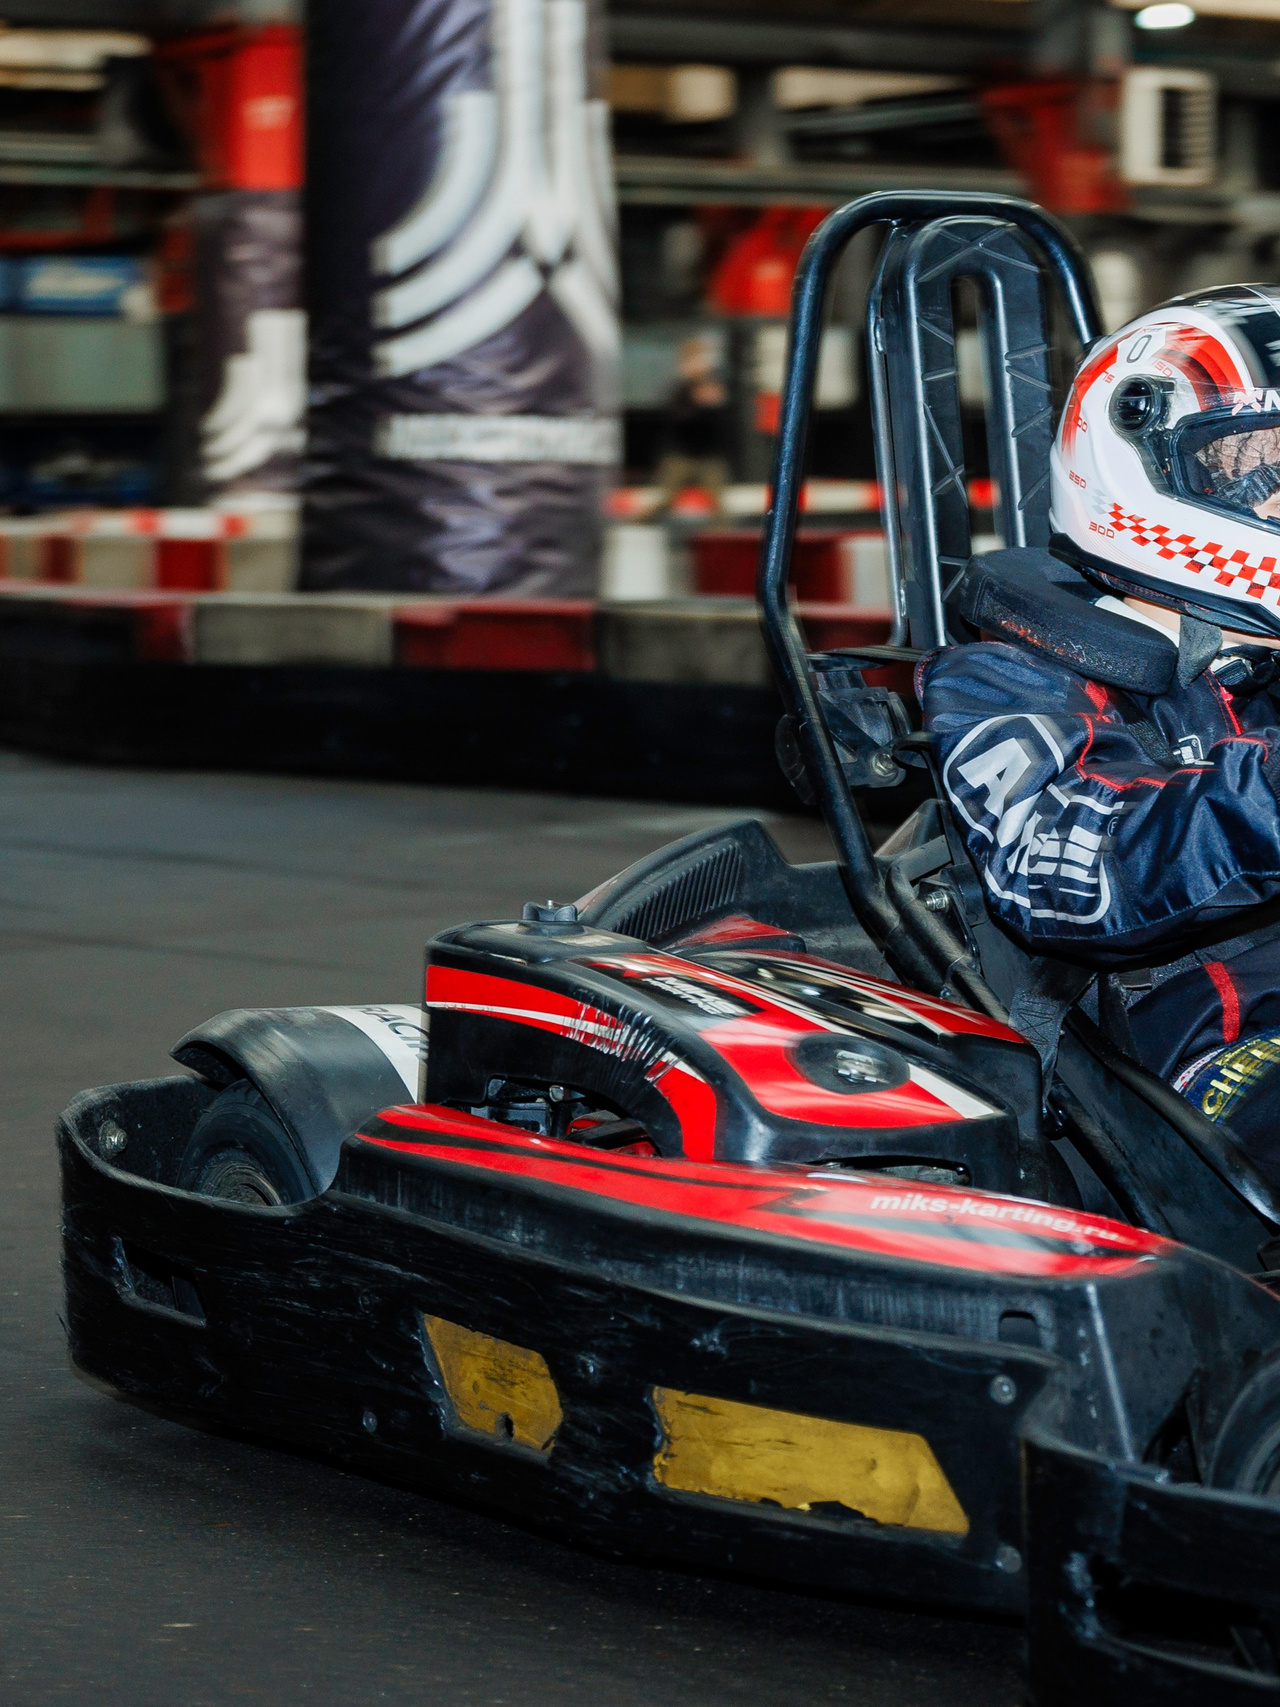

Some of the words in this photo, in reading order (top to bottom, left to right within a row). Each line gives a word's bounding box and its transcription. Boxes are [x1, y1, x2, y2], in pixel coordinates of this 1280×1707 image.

[1069, 469, 1087, 489] 250
[1088, 521, 1115, 539] 300
[870, 1193, 1120, 1241] miks-karting.ru
